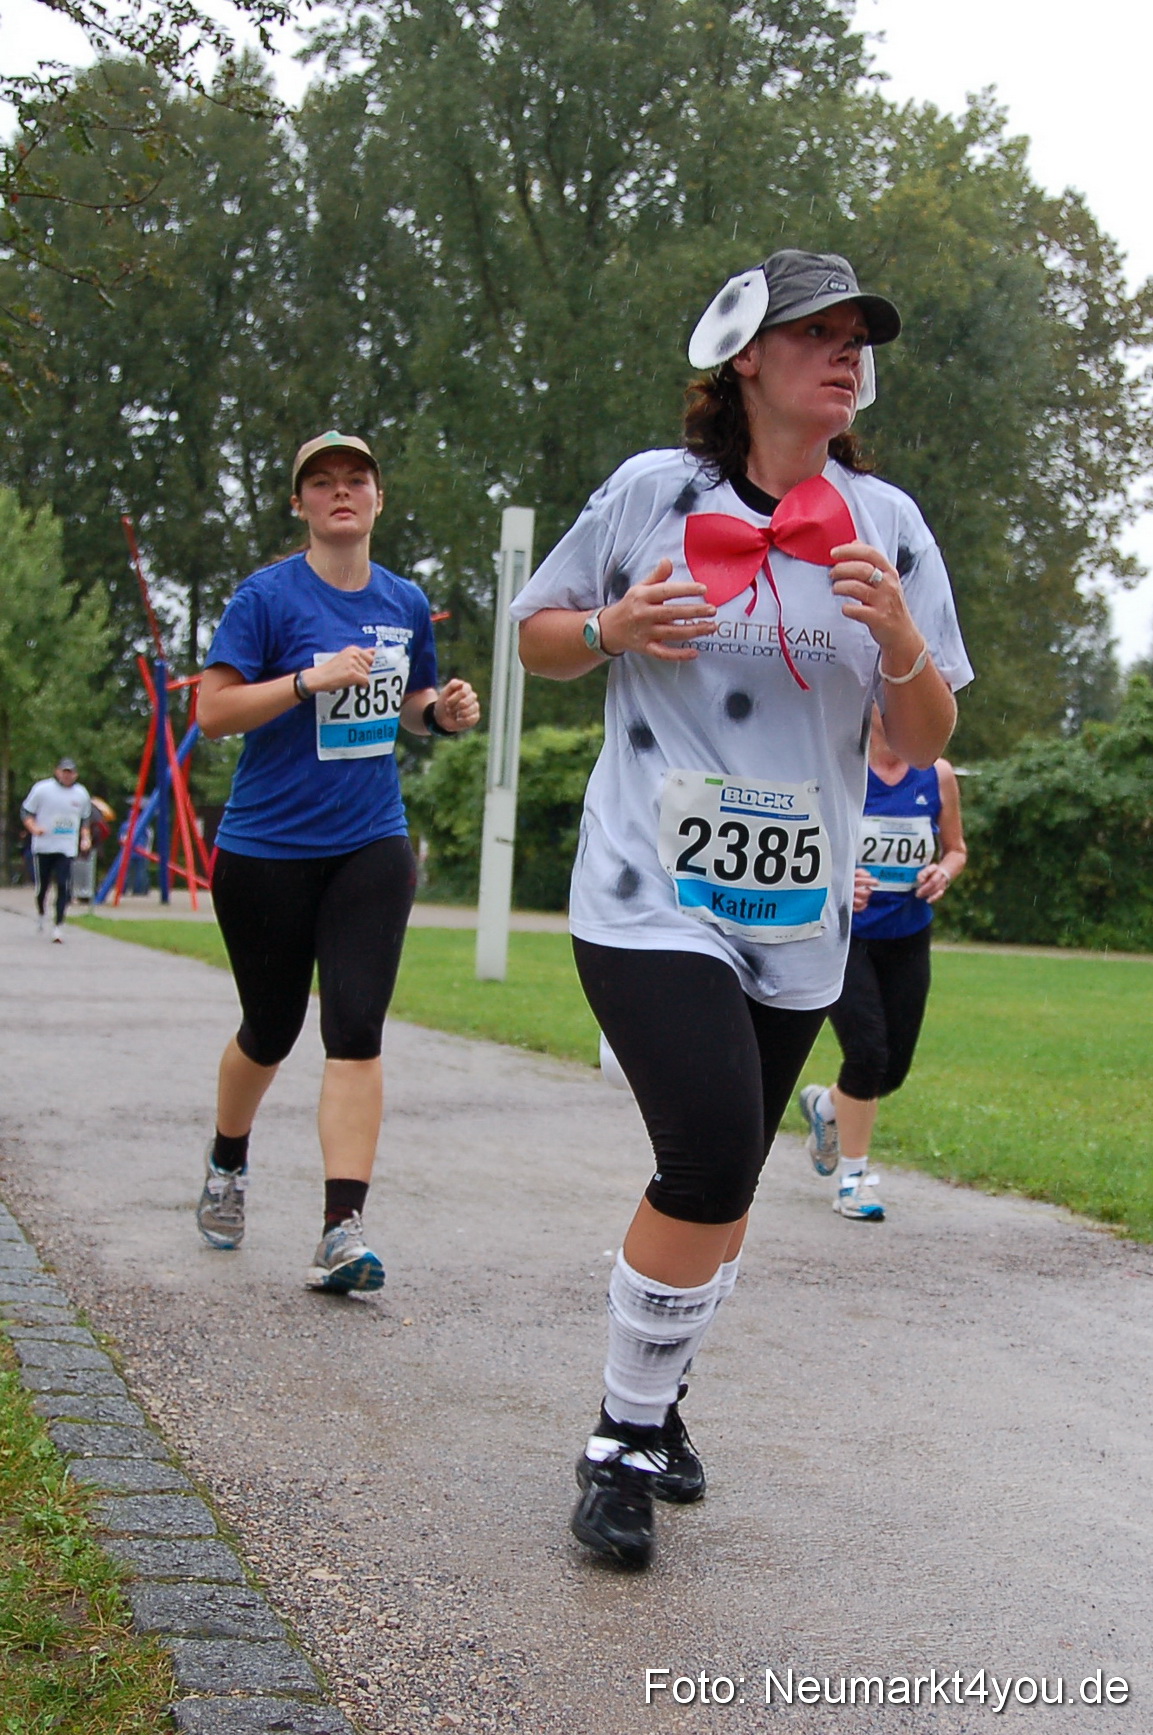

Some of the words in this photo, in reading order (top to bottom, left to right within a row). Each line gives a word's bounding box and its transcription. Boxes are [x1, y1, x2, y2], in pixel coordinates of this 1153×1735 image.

[330, 675, 403, 720] 2853
[348, 725, 394, 743] Daniela
[721, 787, 794, 810] BOCK
[676, 817, 820, 885] 2385
[861, 837, 926, 864] 2704
[711, 891, 777, 919] Katrin
